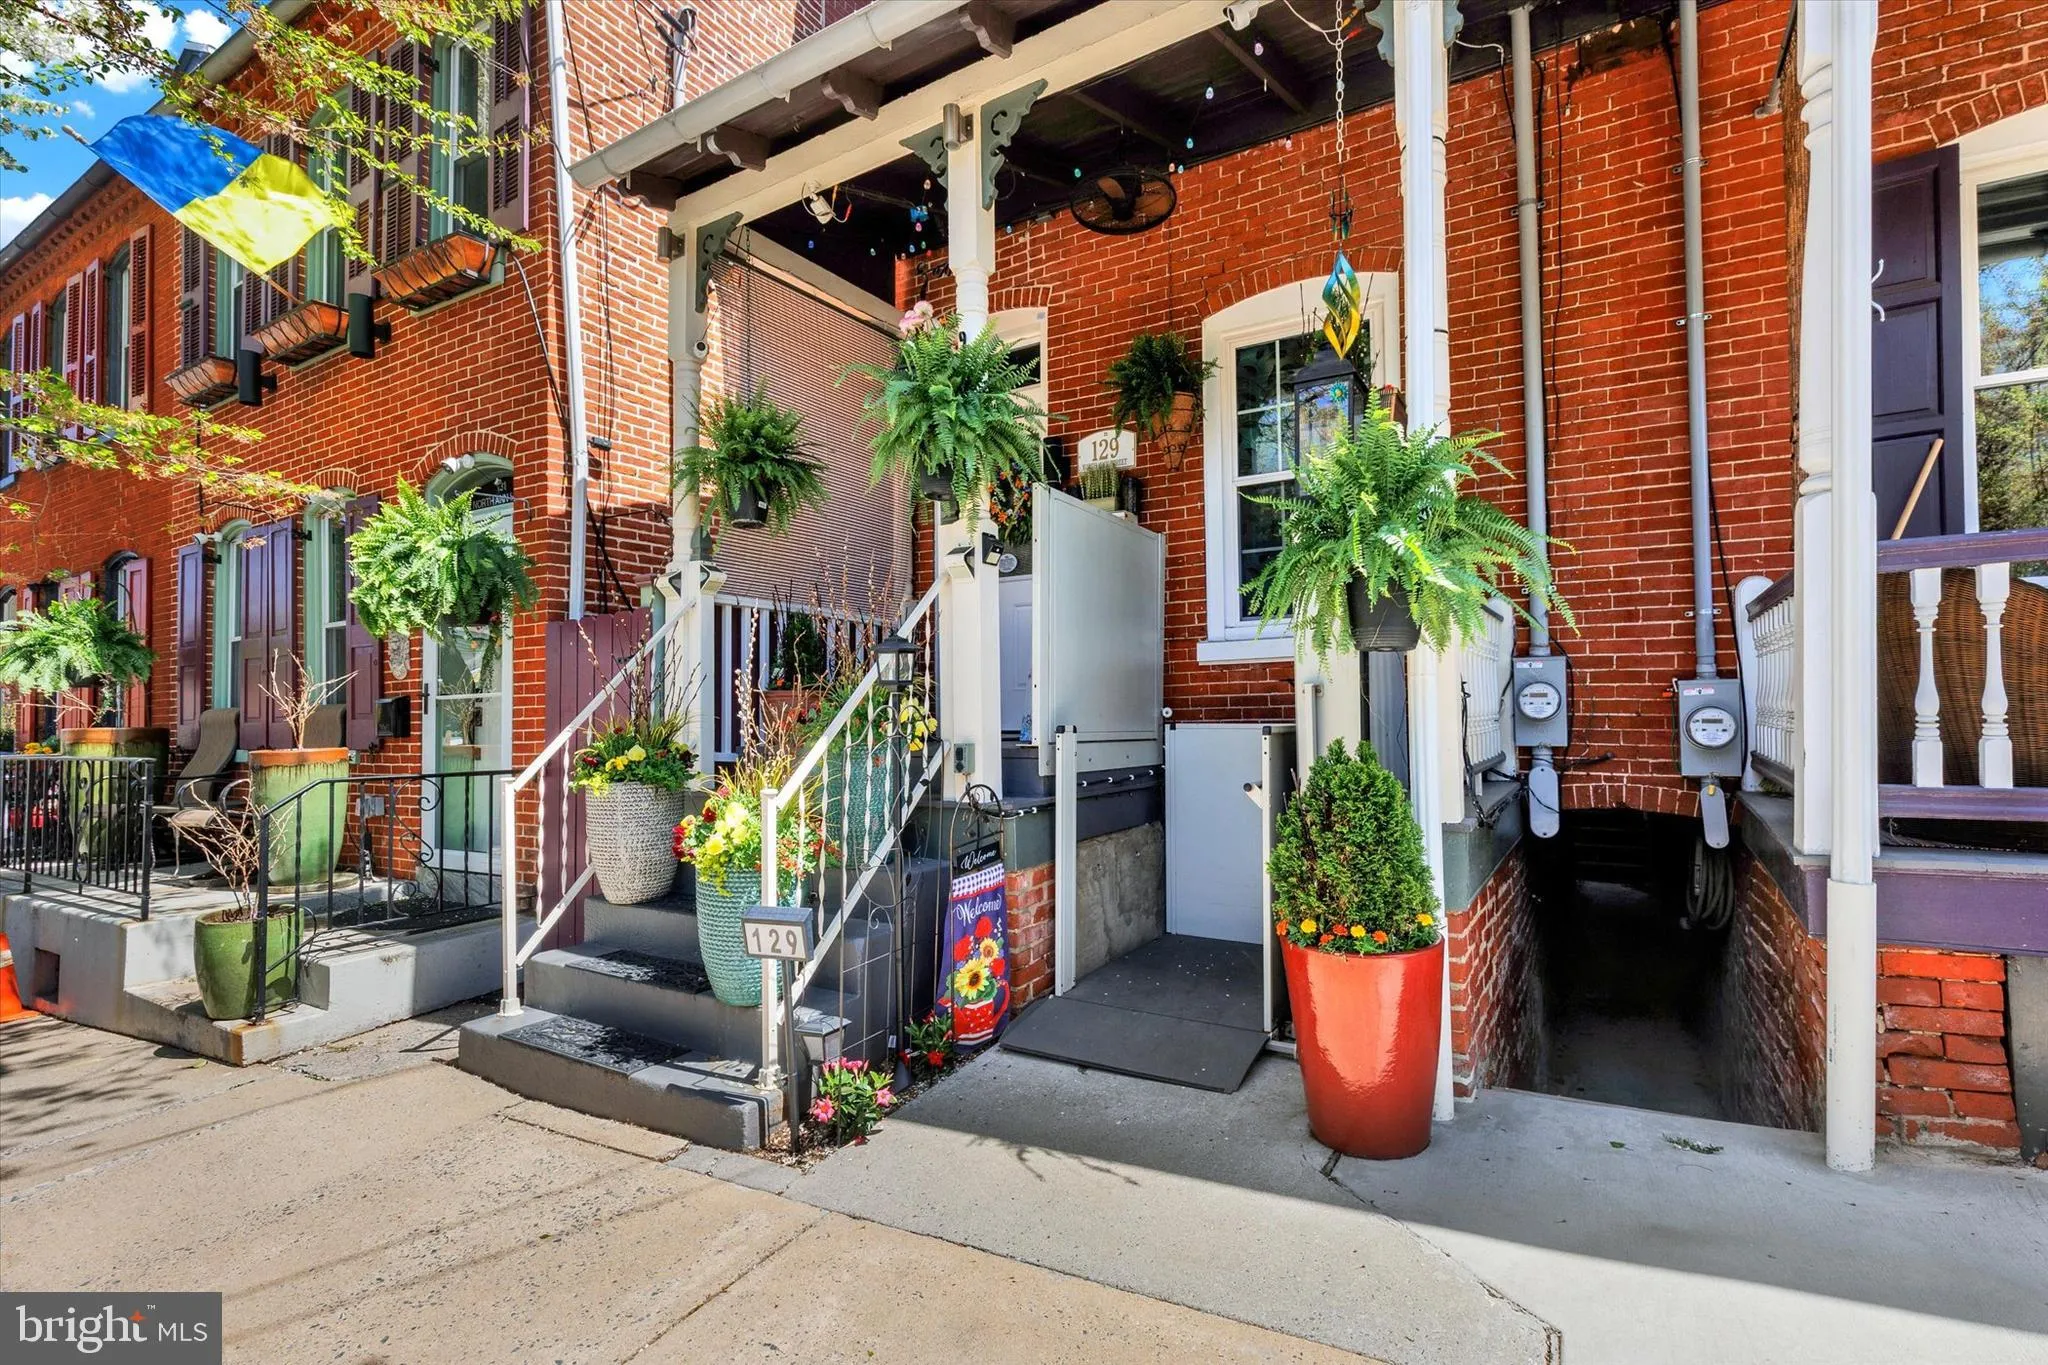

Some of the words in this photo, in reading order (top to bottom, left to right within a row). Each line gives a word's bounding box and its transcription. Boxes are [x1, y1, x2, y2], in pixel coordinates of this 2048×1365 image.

[1092, 437, 1119, 461] 129
[472, 495, 495, 509] NORTH
[960, 849, 997, 870] Welcome
[952, 893, 1002, 926] Welcome
[752, 927, 798, 955] 129
